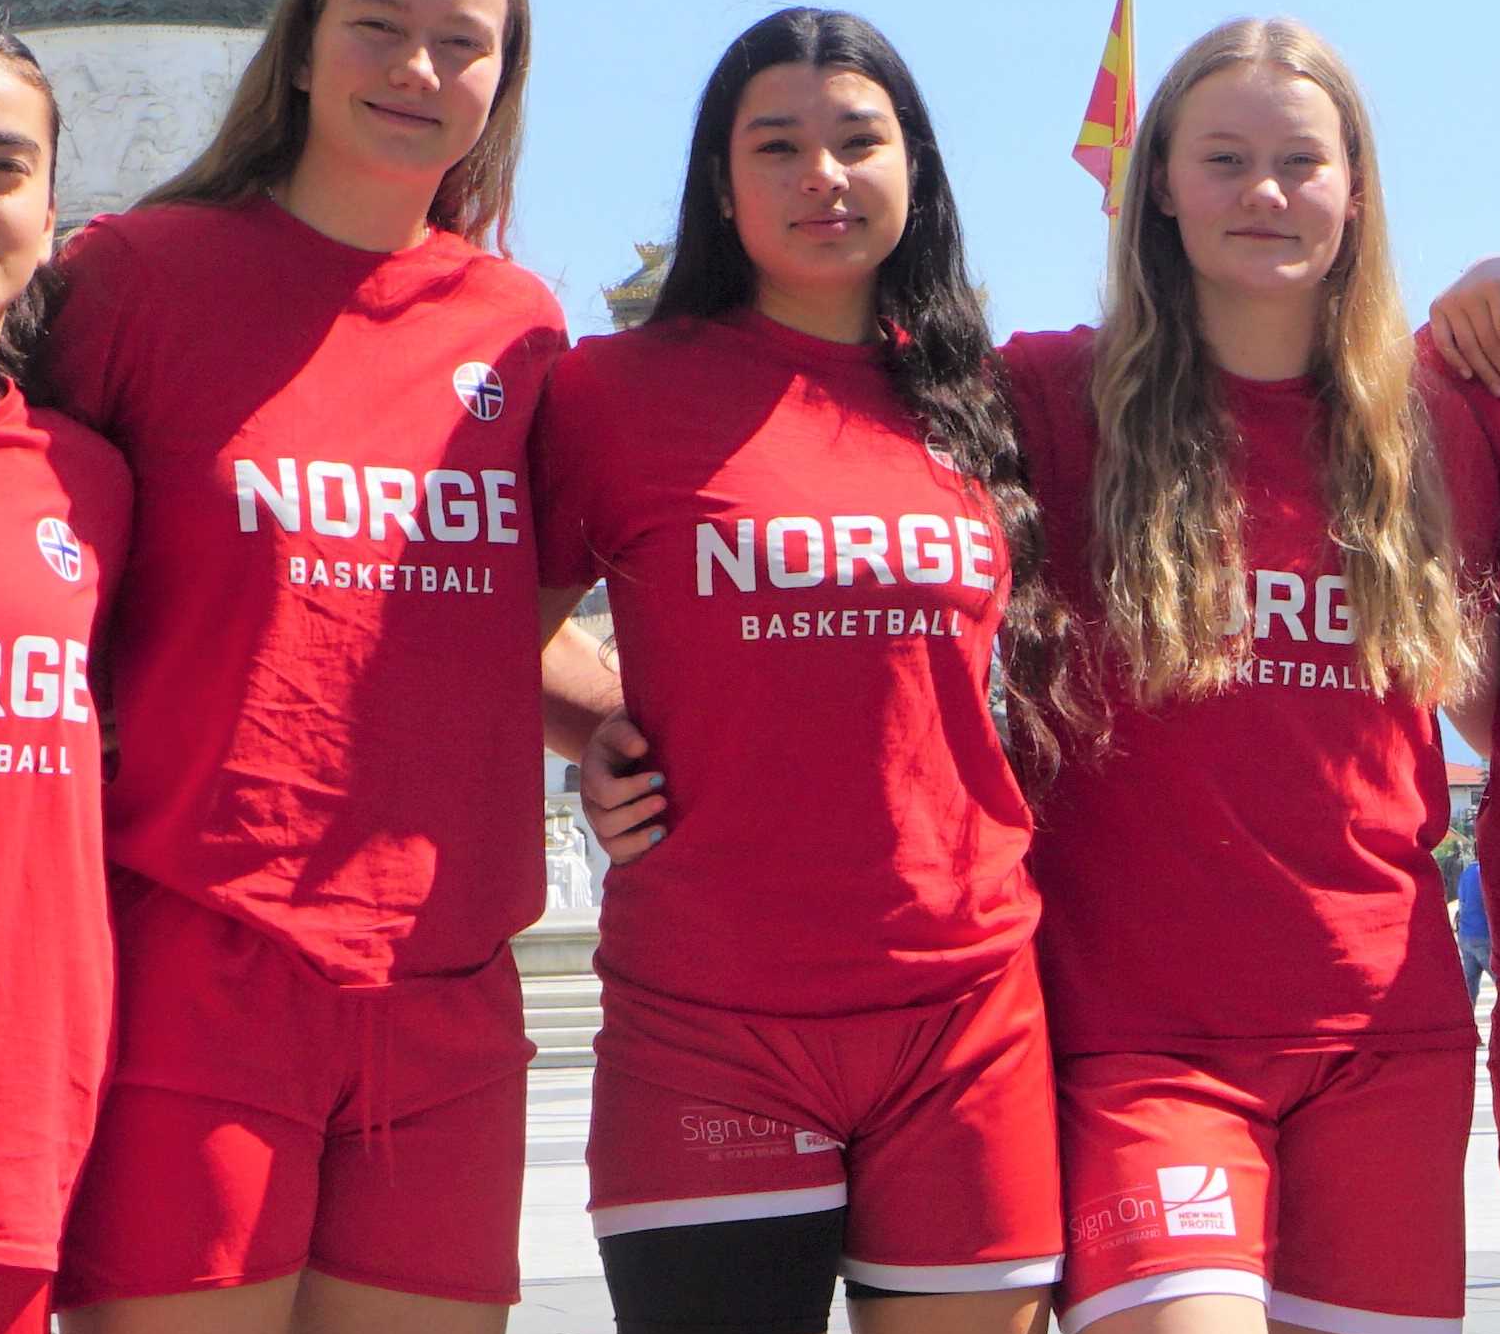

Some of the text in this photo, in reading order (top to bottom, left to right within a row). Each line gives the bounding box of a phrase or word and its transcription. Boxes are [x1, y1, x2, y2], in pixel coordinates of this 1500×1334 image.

[234, 458, 517, 542] NORGE
[697, 513, 995, 595] NORGE
[290, 557, 492, 592] BASKETBALL
[743, 610, 962, 639] BASKETBALL
[681, 1115, 787, 1145] Sign On
[1068, 1197, 1156, 1244] Sign On
[1180, 1219, 1226, 1230] PROFILE
